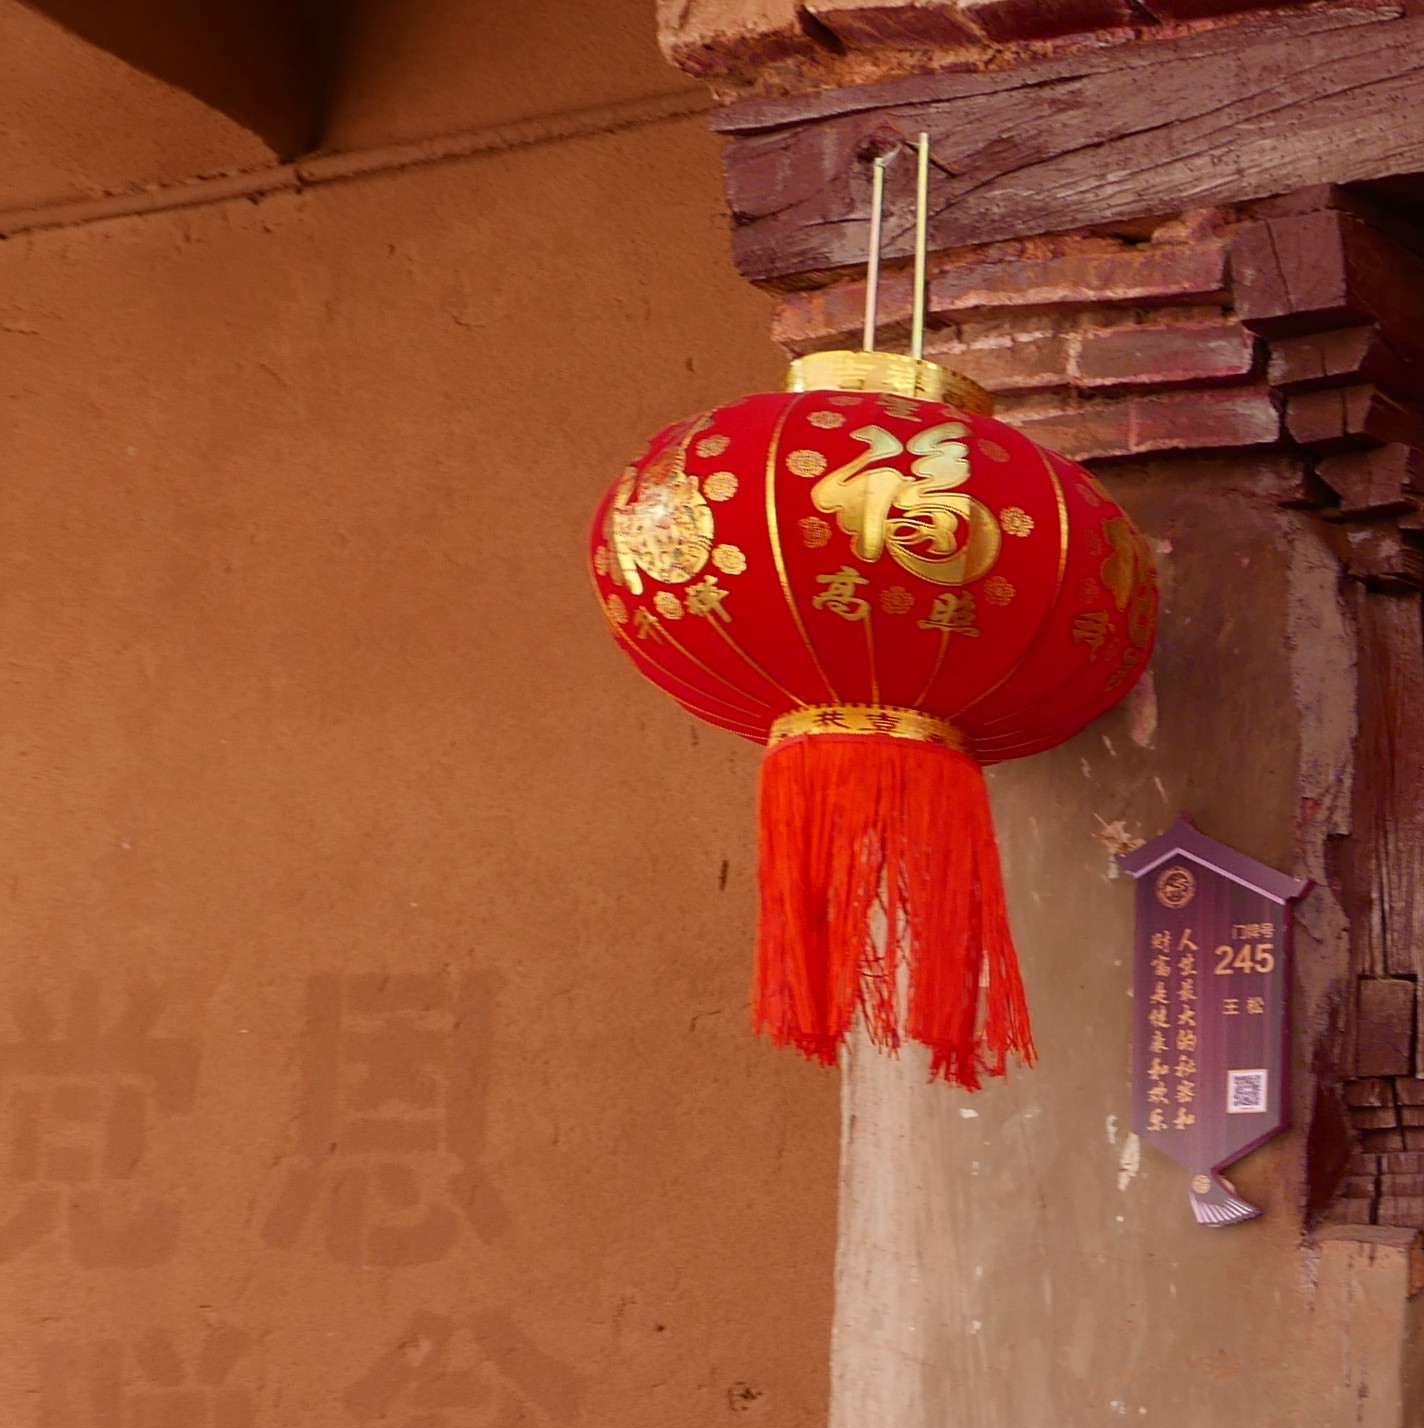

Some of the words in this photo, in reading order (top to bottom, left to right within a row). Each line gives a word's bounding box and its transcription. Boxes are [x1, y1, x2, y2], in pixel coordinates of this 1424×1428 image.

[810, 421, 1001, 587] 福
[811, 565, 983, 638] 高照
[1231, 922, 1276, 940] 门牌号
[1214, 943, 1275, 975] 245
